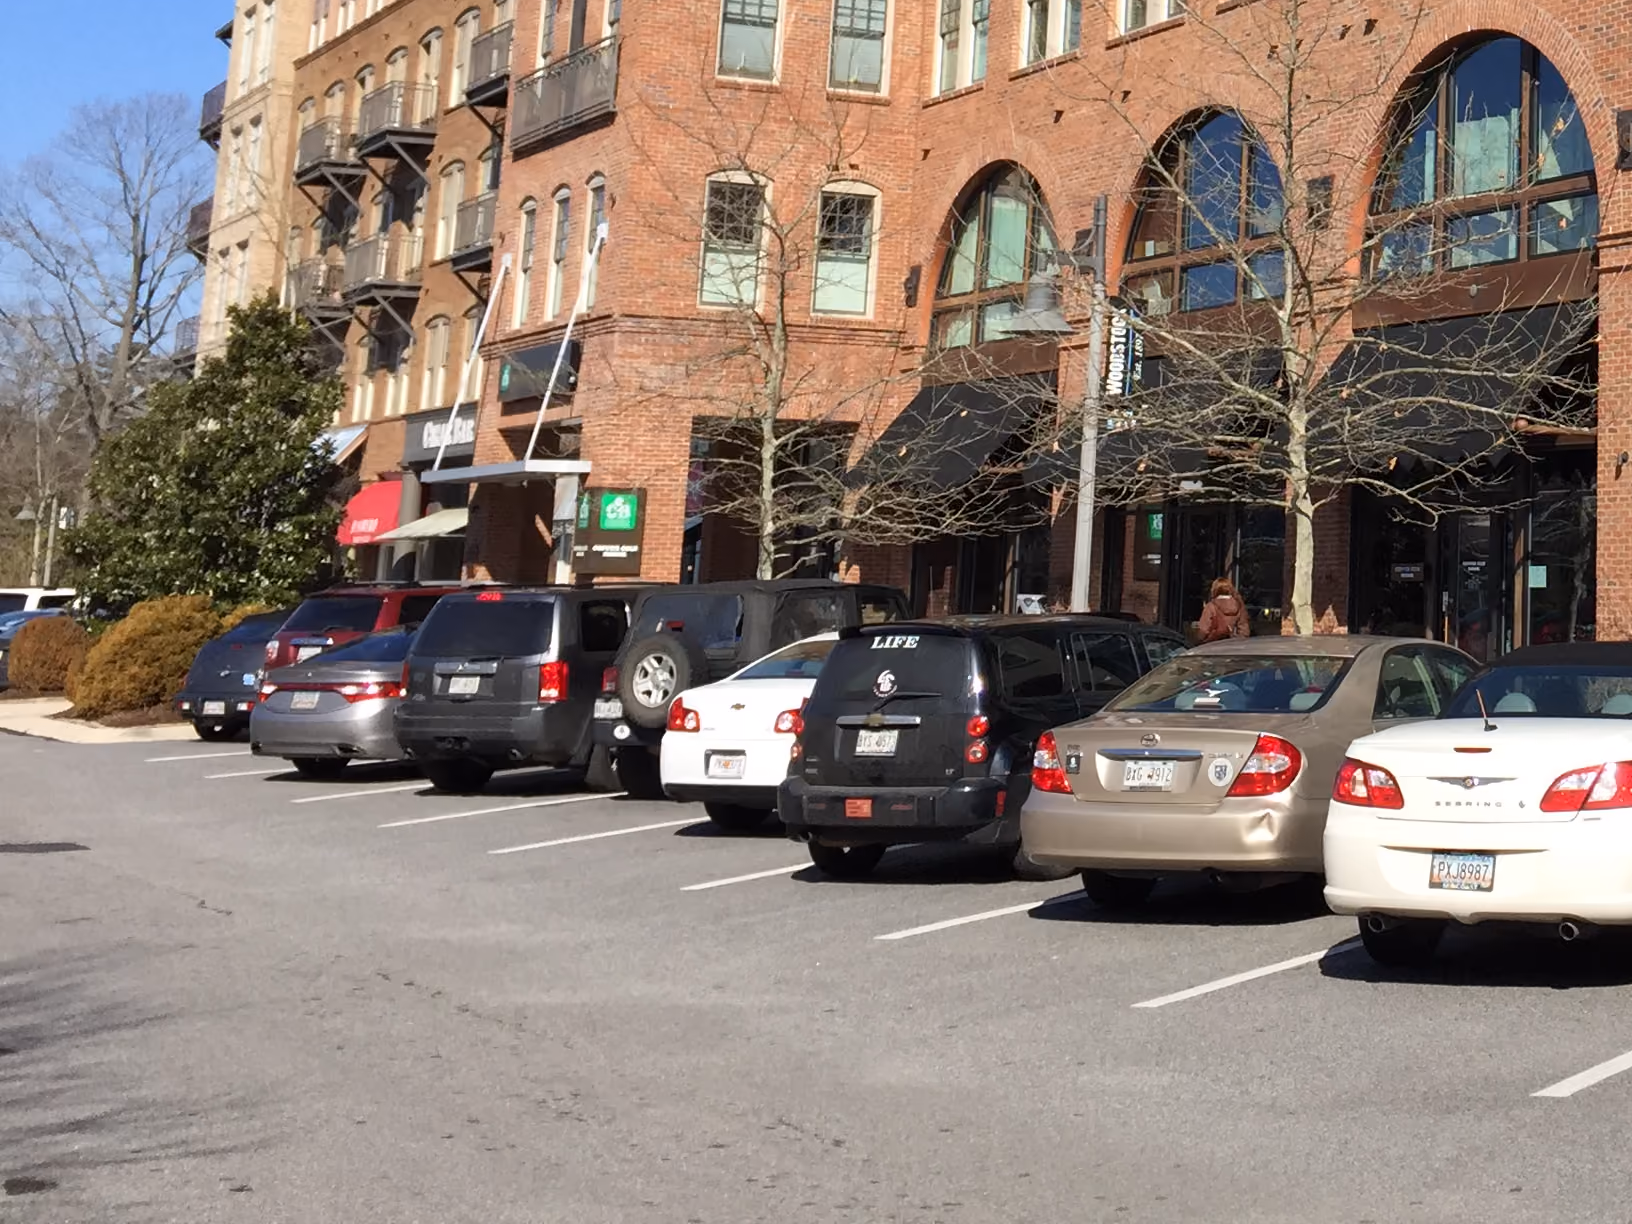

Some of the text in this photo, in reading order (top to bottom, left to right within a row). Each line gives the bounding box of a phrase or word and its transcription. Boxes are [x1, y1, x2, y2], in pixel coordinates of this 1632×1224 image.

[870, 635, 920, 649] LIFE
[1434, 800, 1502, 808] SEBRING
[1438, 861, 1489, 882] PXJ8987
